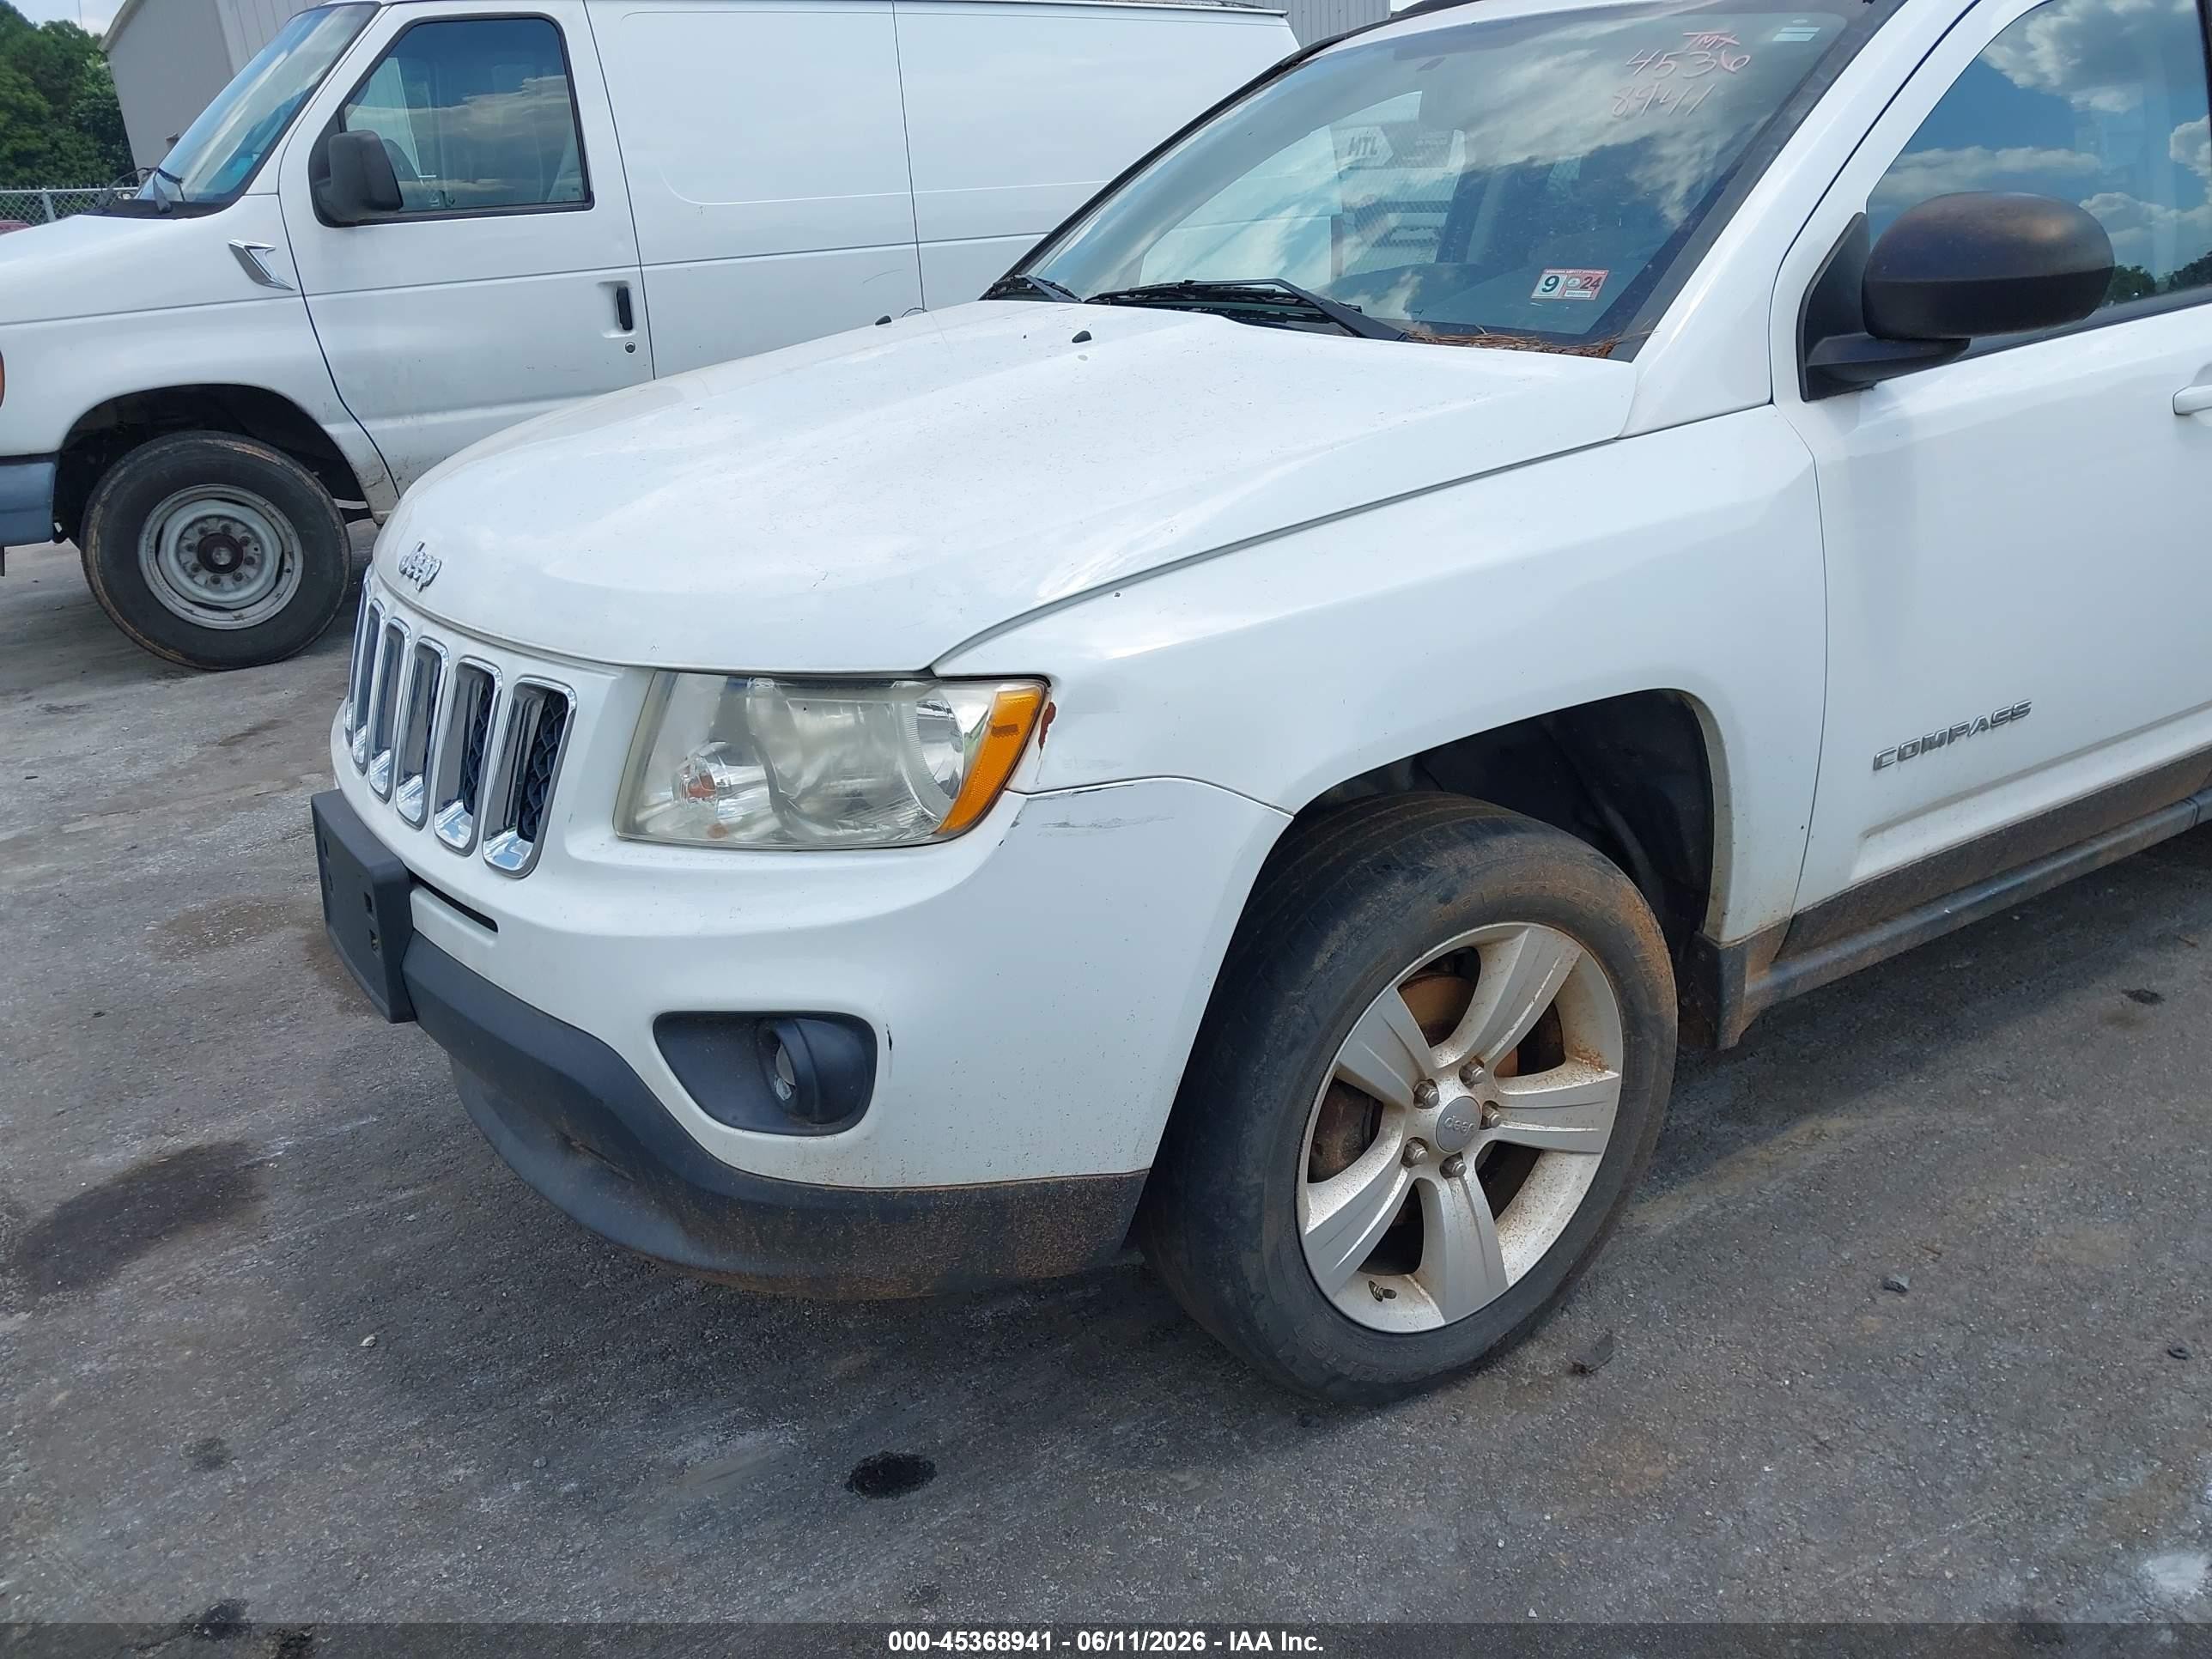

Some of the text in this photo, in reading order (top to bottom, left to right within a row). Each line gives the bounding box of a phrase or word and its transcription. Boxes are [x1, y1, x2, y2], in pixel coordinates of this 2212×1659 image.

[1626, 48, 1752, 80] 4536
[1541, 275, 1602, 293] 9 24
[398, 540, 443, 592] Jeep
[1873, 698, 2033, 772] COMPASS
